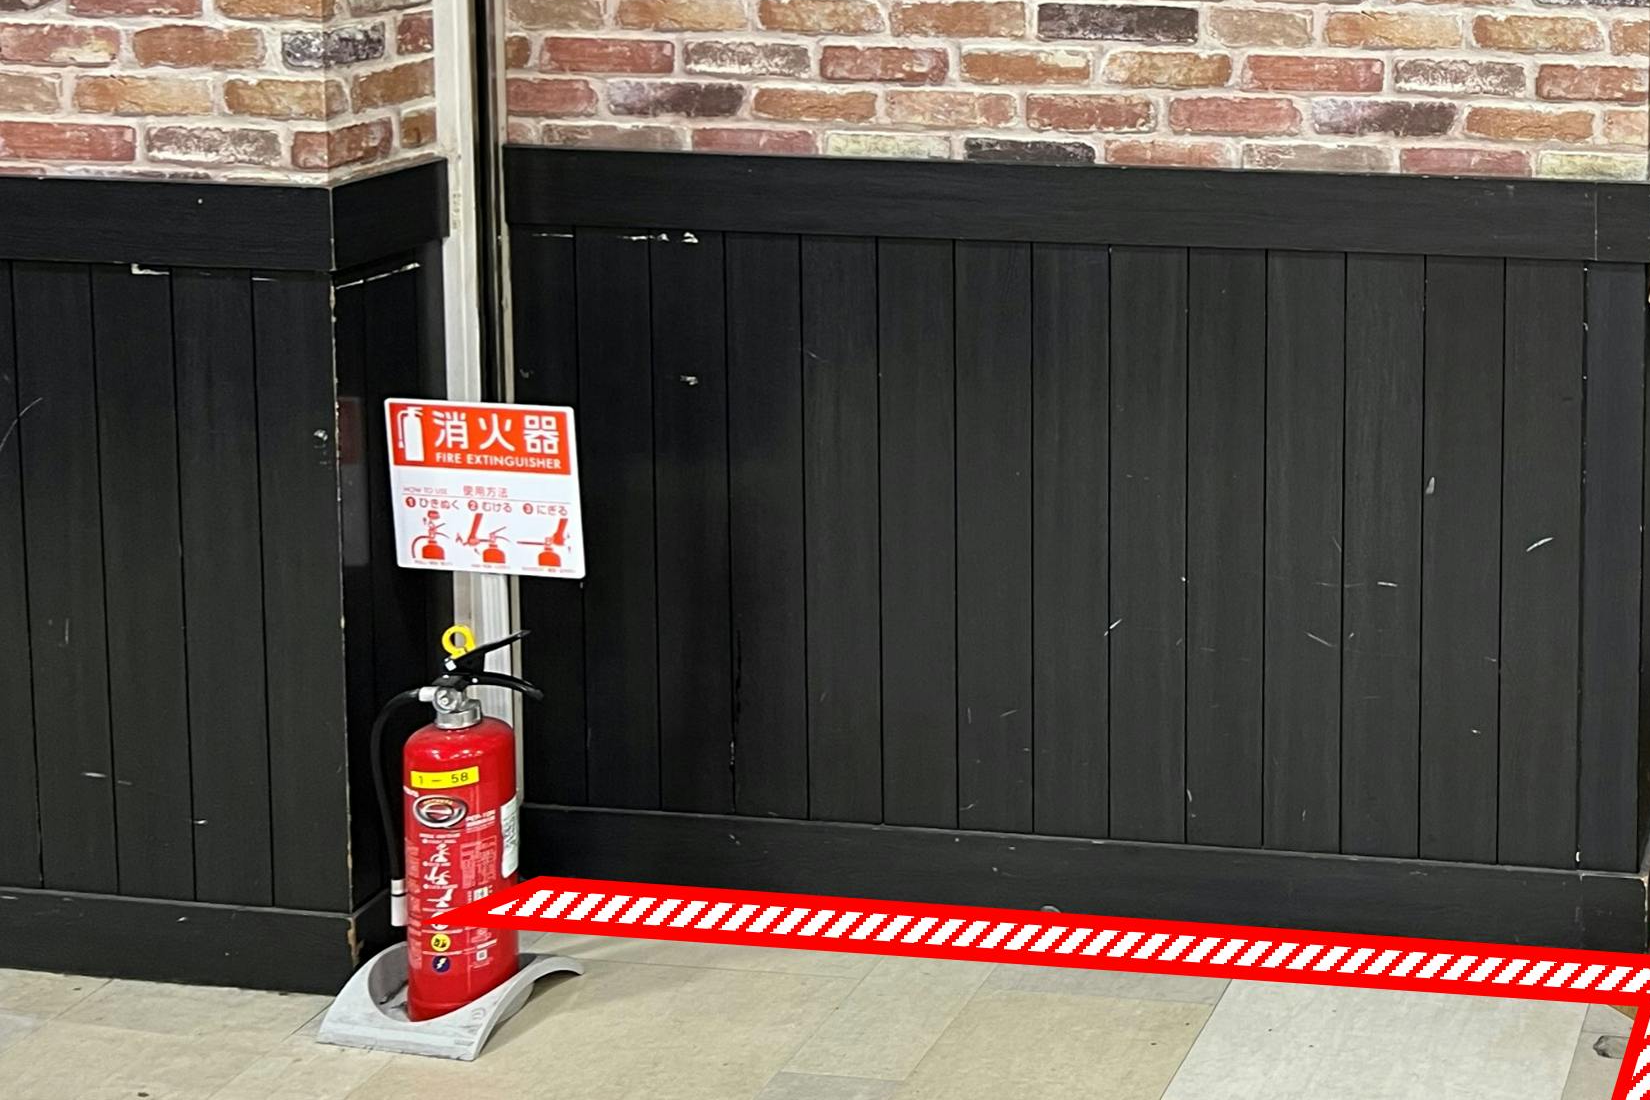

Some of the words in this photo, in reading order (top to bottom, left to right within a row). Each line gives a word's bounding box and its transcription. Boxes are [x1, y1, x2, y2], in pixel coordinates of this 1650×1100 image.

[432, 410, 559, 454] 消火器
[435, 452, 462, 464] FIRE
[466, 454, 561, 469] EXTINGUISHER
[463, 484, 509, 498] 使用方法
[451, 771, 470, 783] 58
